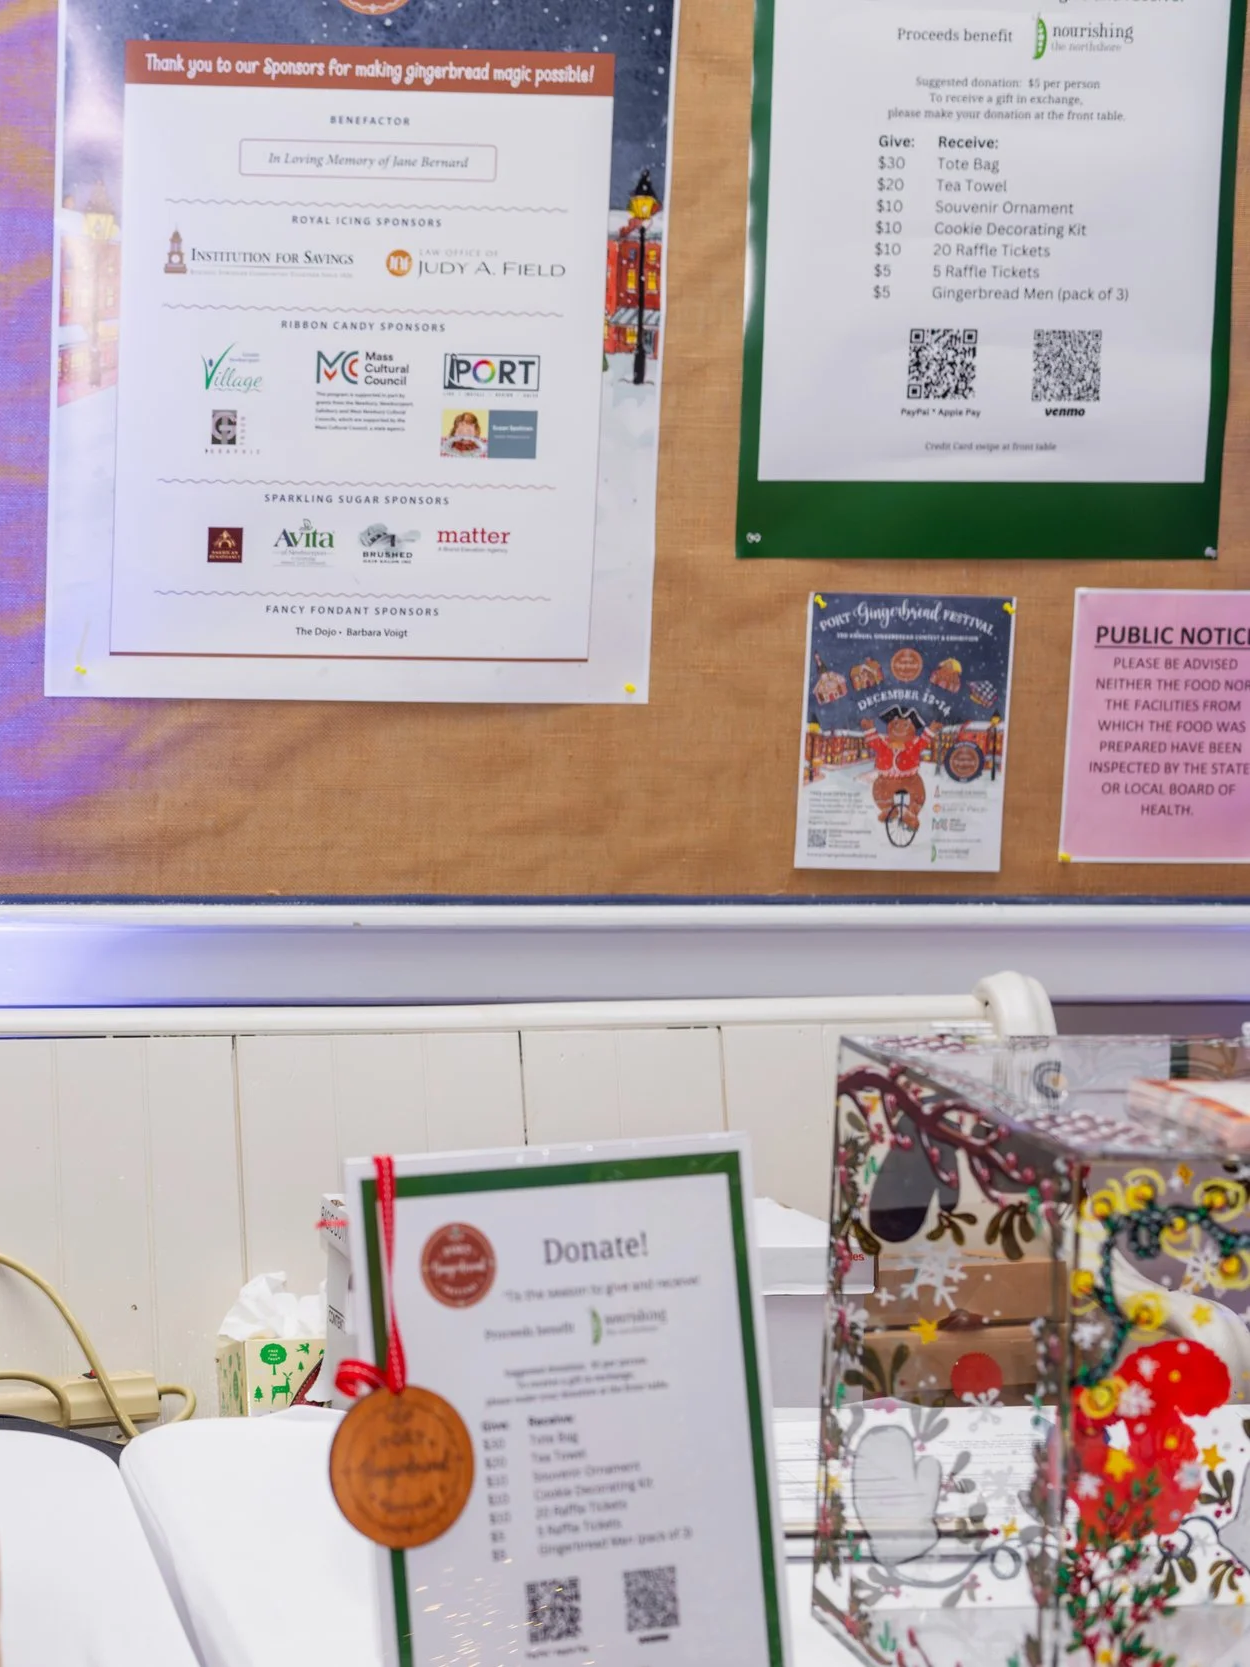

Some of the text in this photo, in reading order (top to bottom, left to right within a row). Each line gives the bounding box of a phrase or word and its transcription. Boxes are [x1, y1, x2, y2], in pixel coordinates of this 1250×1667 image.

[897, 27, 1013, 43] Proceeds benefit
[1053, 22, 1134, 43] nourishing
[145, 52, 595, 88] Thank you to our Sponsors for making gingerbread magic possible!
[915, 76, 1100, 92] Suggested donation: $5 per person
[929, 92, 1083, 107] To receive a gift in exchange,
[330, 115, 410, 126] BENEFACTOR
[888, 107, 1125, 122] please make your donation at the front table.
[878, 135, 999, 149] Give: Receive:
[268, 152, 469, 169] In Loving Memory of Jane Bernard
[878, 155, 999, 174] $30 Tote Bag
[877, 177, 1007, 193] $20 Tea Towel
[876, 199, 1073, 215] $10 Souvenir Ornament
[292, 215, 442, 228] ROYAL ICING SPONSORS
[875, 221, 1086, 239] $10 Cookie Decorating Kit
[874, 242, 1050, 258] $10 20 Raffle Tickets
[417, 260, 566, 278] JUDY A. FIELD
[874, 264, 1040, 279] $5 5 Raffle Tickets
[873, 285, 1129, 303] $5 Gingerbread Men (pack of 3)
[280, 320, 446, 332] RIBBON CANDY SPONSORS
[365, 351, 393, 361] Mass
[200, 341, 263, 393] Village
[364, 363, 409, 374] Cultural
[455, 358, 536, 385] PORT
[364, 375, 407, 386] Council
[901, 408, 930, 418] PayPal
[938, 408, 963, 418] Apple
[966, 408, 981, 418] Pay
[1045, 408, 1085, 417] venmo
[925, 442, 950, 451] Credit
[953, 442, 973, 451] Card
[264, 493, 449, 505] SPARKLING SUGAR SPONSORS
[273, 527, 334, 549] Avita
[437, 527, 511, 545] matter
[362, 551, 413, 559] BRUSHED
[266, 605, 440, 616] FANCY FONDANT SPONSORS
[819, 599, 995, 636] PORT Gingerbread FESTIVAL
[296, 627, 408, 639] The Dojo Barbara Voigt
[1096, 626, 1174, 645] PUBLIC
[1114, 657, 1238, 671] PLEASE BE ADVISED
[1096, 678, 1250, 692] NEITHER THE FOOD NOR
[857, 688, 919, 711] DECEMBER
[1104, 699, 1241, 712] THE FACILITIES FROM
[1098, 720, 1246, 734] WHICH THE FOOD WAS
[1099, 741, 1242, 754] PREPARED HAVE BEEN
[1089, 761, 1250, 775] INSPECTED BY THE STATE
[1101, 782, 1235, 796] OR LOCAL BOARD OF
[1141, 804, 1193, 816] HEALTH.
[543, 1231, 649, 1266] Donate!
